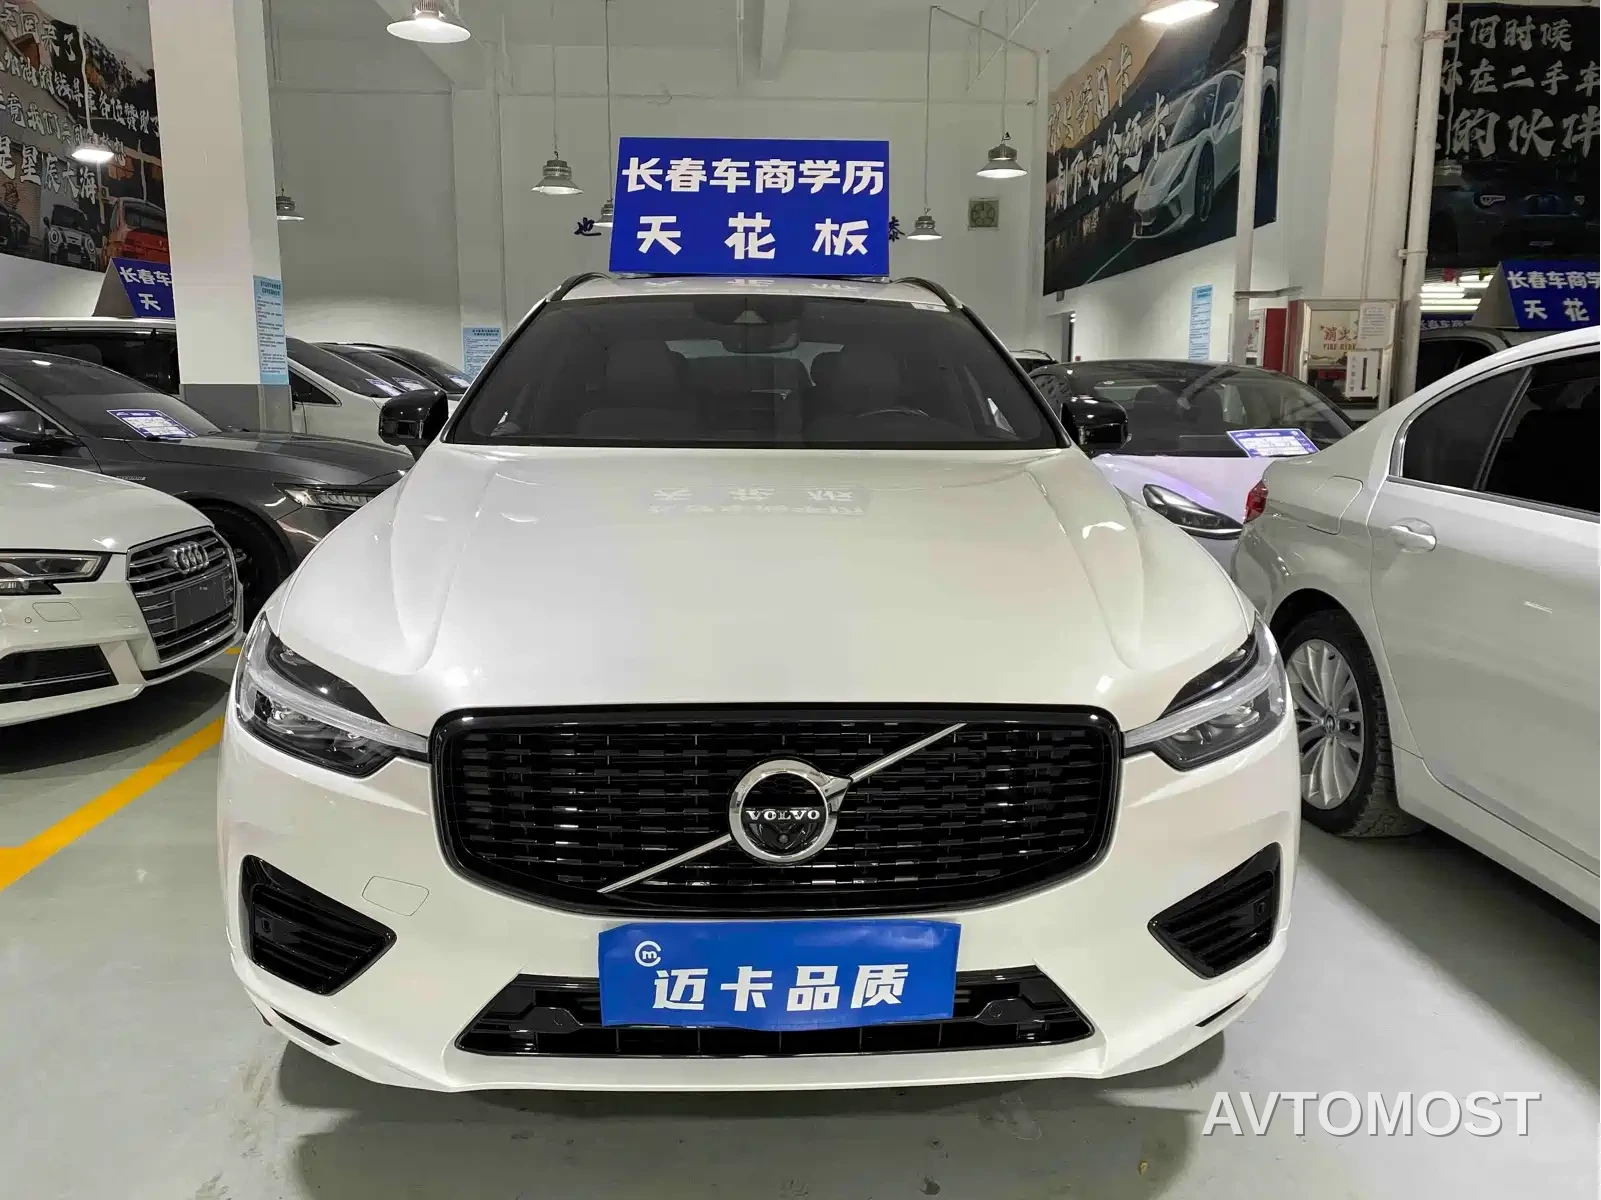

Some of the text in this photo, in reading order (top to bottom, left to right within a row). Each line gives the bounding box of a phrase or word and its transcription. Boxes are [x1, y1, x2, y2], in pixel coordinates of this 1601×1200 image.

[1436, 105, 1600, 159] 的伙伴
[622, 157, 884, 195] 长春车商学历
[637, 212, 869, 259] 天花板
[138, 293, 161, 311] 天
[1524, 298, 1590, 322] 天花
[1323, 325, 1357, 341] 消火
[745, 808, 820, 821] VOLVO
[652, 963, 909, 1012] 迈卡品质
